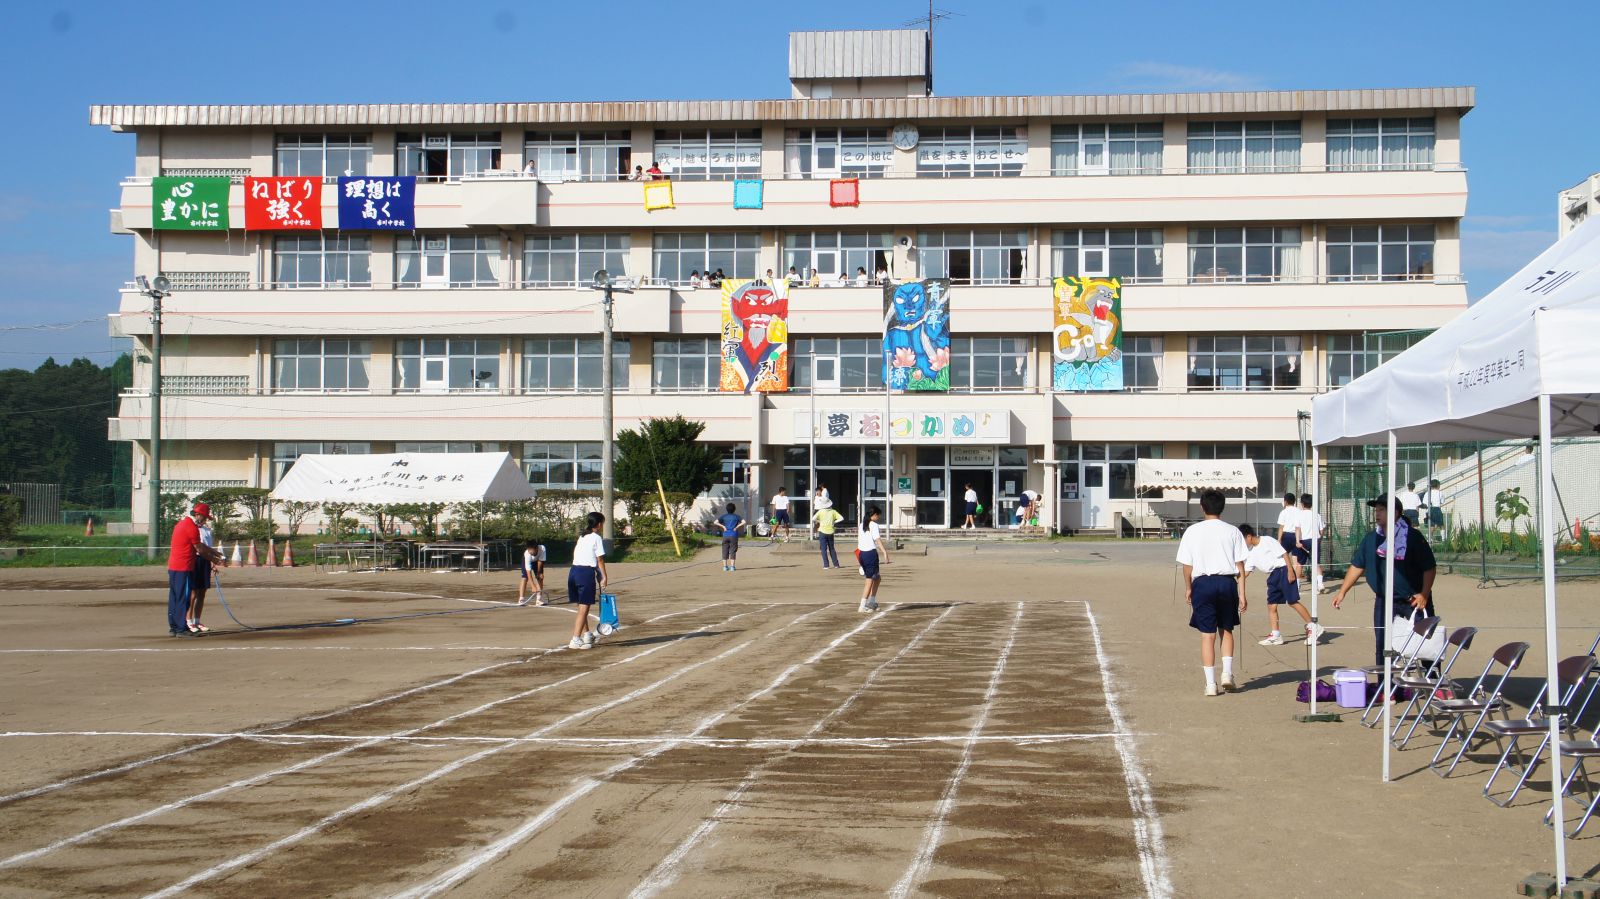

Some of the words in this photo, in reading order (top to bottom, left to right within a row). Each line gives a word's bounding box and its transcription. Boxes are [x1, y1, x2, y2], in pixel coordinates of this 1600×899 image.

[843, 151, 892, 161] この地に
[172, 181, 194, 197] 心
[251, 179, 313, 199] ねばり
[345, 179, 402, 200] 理想は
[160, 199, 220, 222] 豊かに
[265, 199, 304, 221] 強く
[361, 200, 392, 218] 高く
[1053, 324, 1094, 361] Go
[754, 361, 779, 382] 烈
[827, 413, 975, 438] 夢をつかめ
